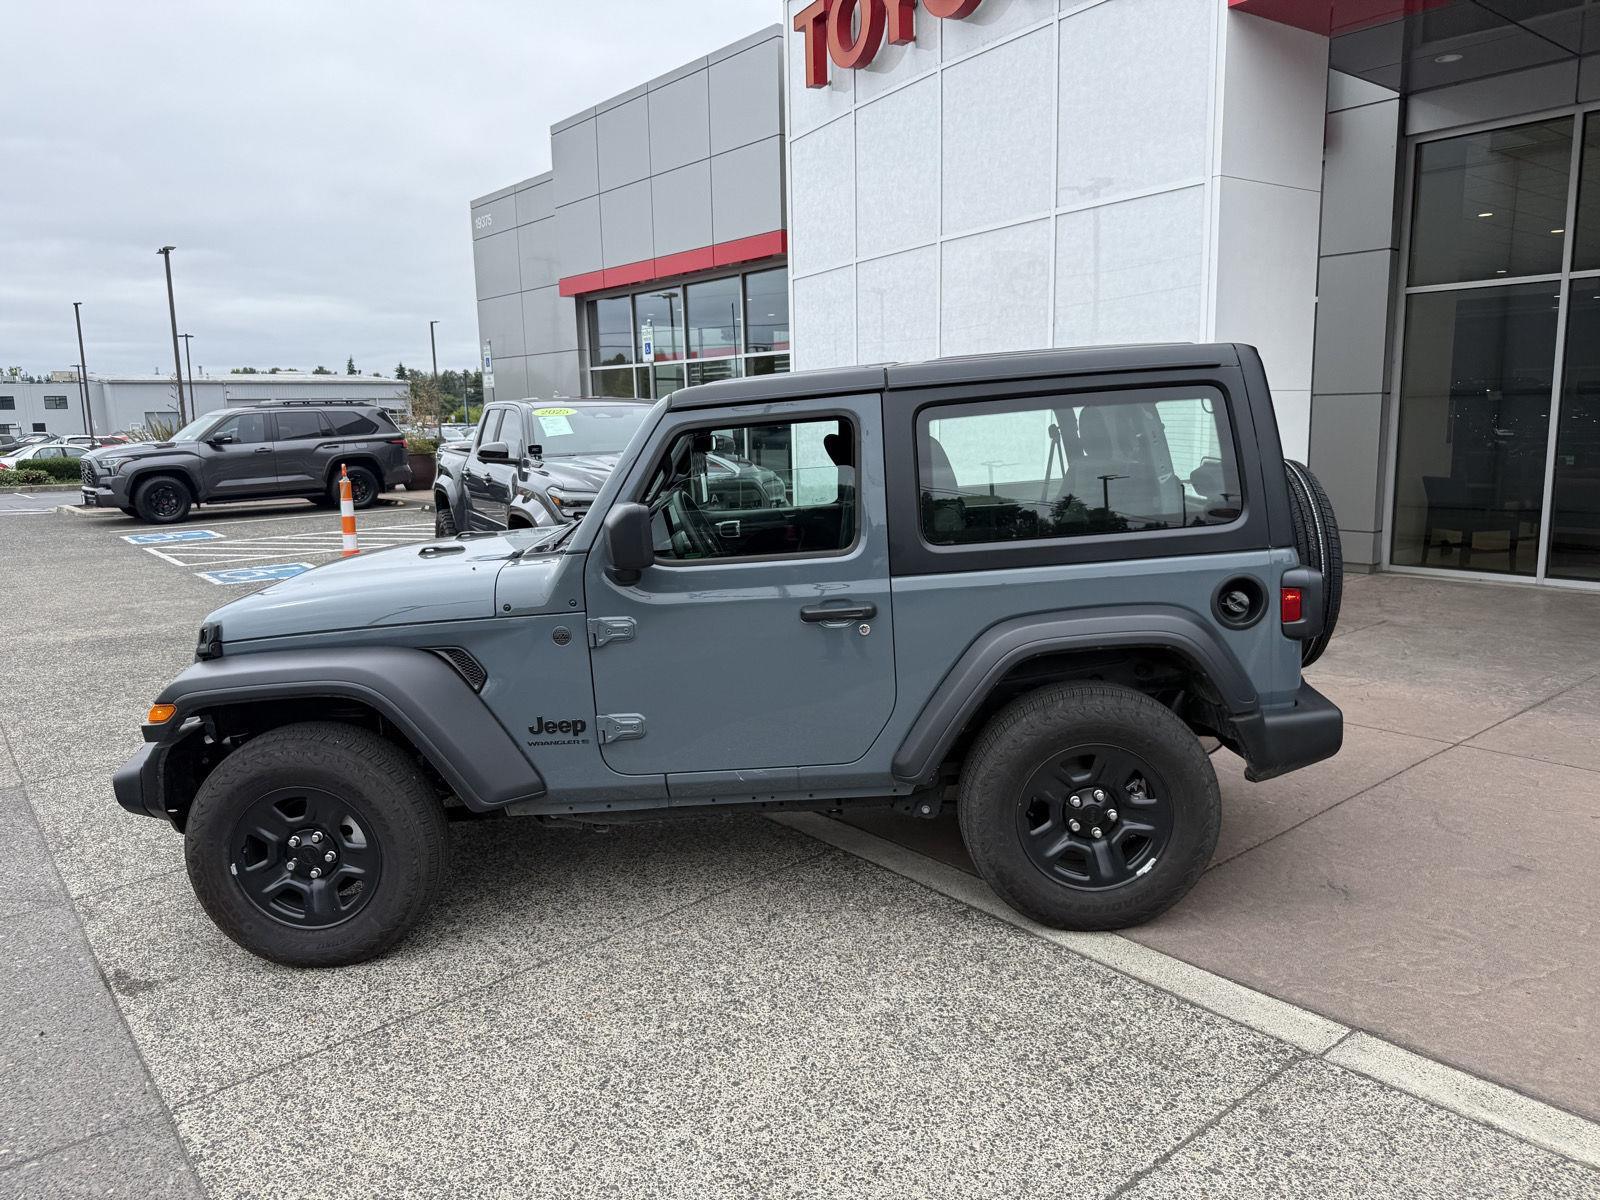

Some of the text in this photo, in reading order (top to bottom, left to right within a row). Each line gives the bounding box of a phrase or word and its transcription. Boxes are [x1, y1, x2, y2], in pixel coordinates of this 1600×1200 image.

[475, 213, 492, 230] 19375
[528, 716, 587, 736] Jeep
[527, 739, 580, 747] WRANGLER
